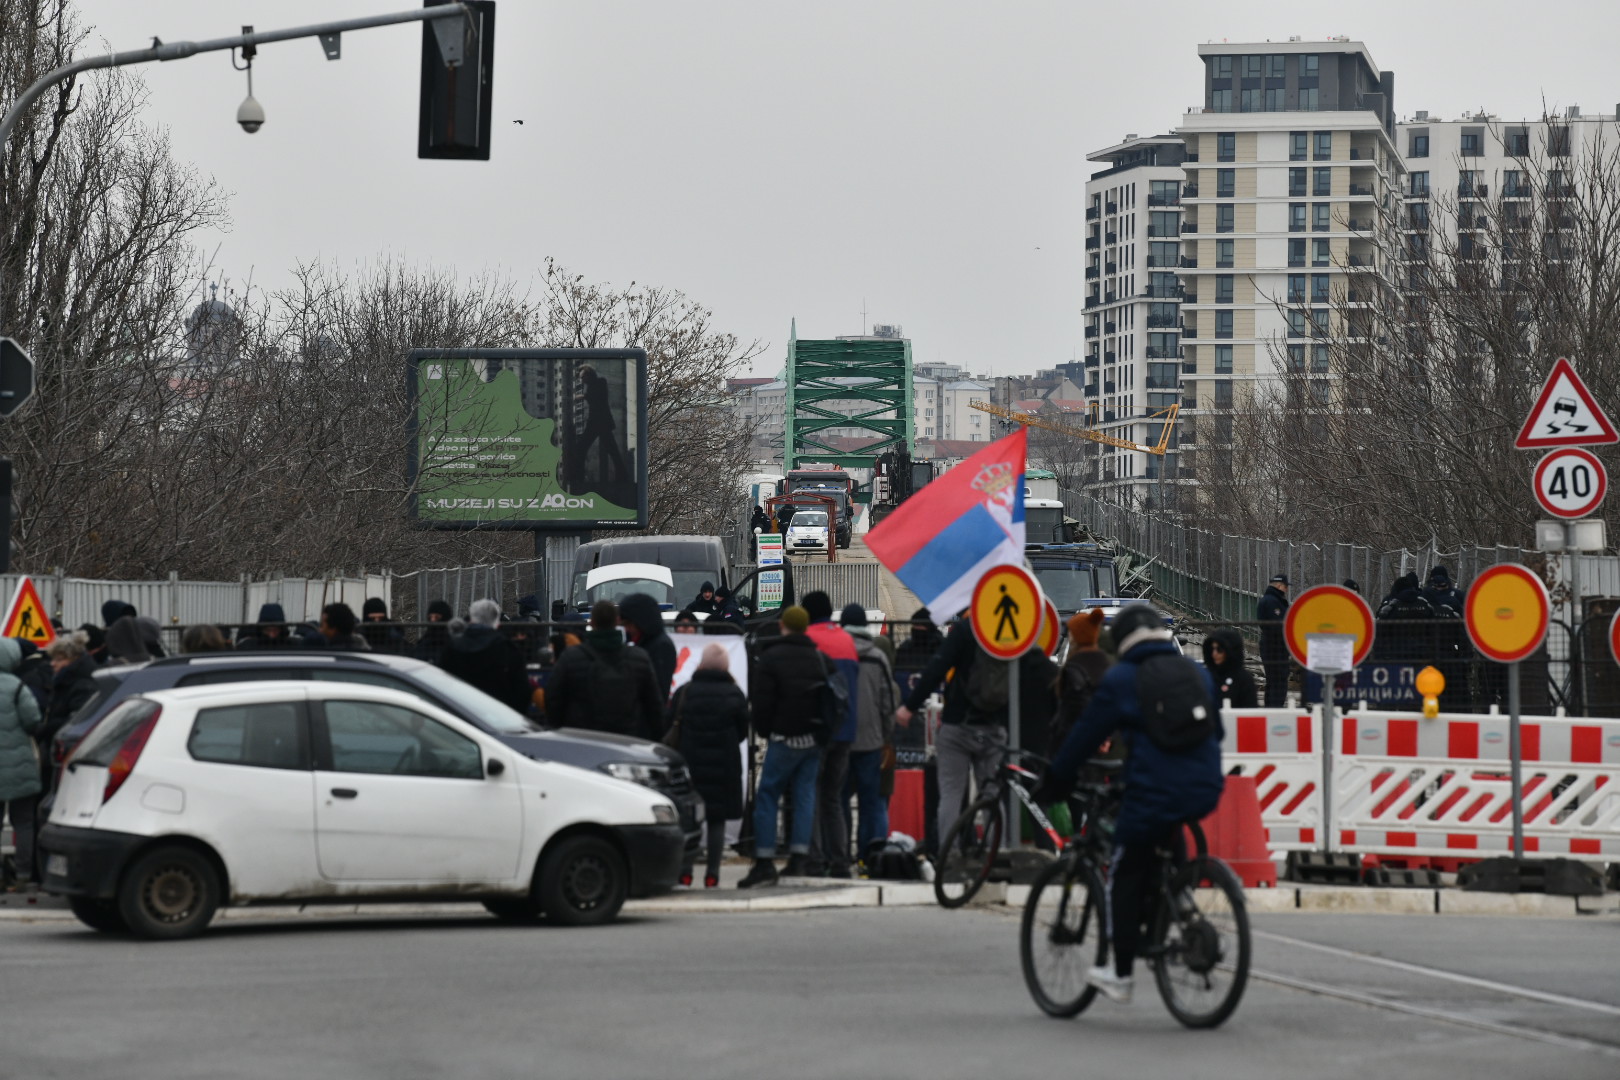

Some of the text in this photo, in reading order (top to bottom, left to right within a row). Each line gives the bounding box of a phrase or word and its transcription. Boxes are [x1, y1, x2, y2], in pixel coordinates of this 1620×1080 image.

[1549, 465, 1590, 499] 40
[427, 498, 494, 509] MUZEJI
[498, 498, 523, 509] SU
[1321, 667, 1414, 685] ТОП
